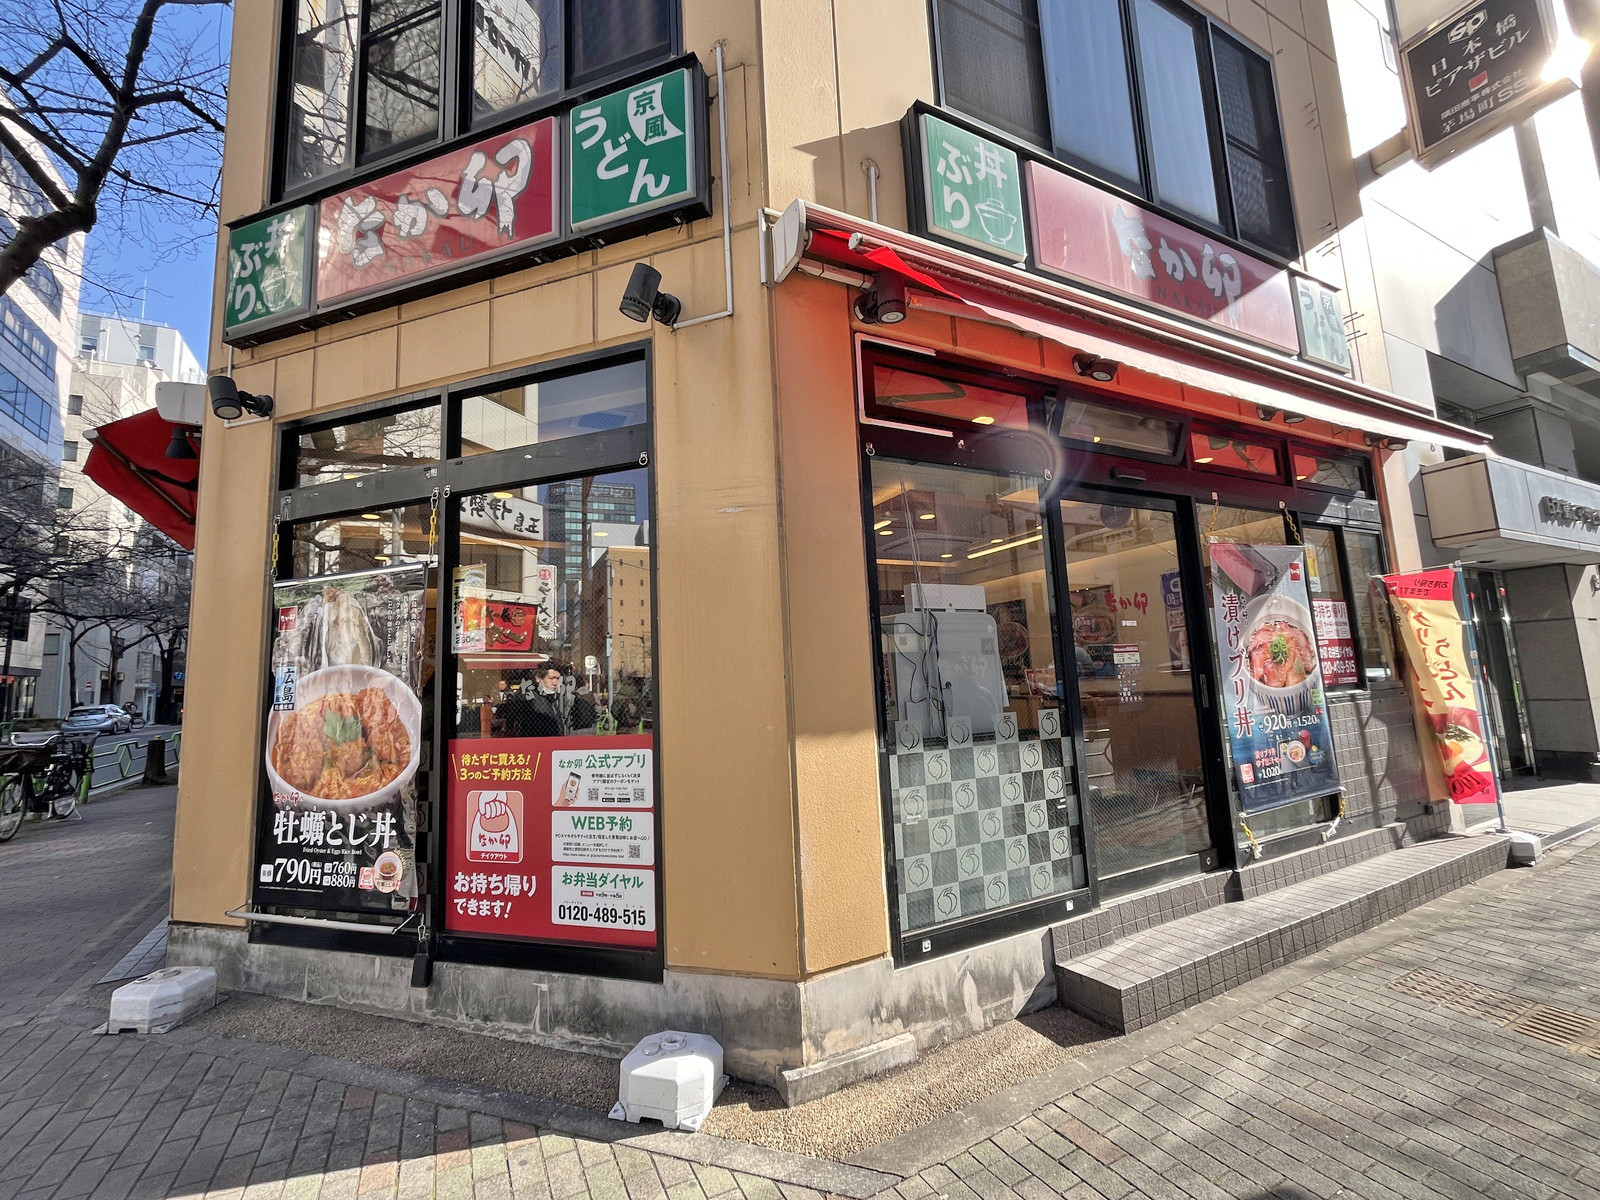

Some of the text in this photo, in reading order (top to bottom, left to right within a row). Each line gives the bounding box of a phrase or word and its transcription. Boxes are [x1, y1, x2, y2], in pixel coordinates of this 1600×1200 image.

[632, 88, 670, 144] 京風
[574, 106, 671, 204] うどん
[975, 141, 1007, 189] 丼
[936, 140, 974, 230] ぶり
[232, 241, 264, 322] ぶり
[1221, 593, 1254, 738] 漬けブリ丼
[282, 668, 295, 702] 広島
[461, 753, 530, 766] 待たずに買える!
[559, 753, 646, 769] なか卯 公式アプリ
[460, 768, 532, 780] 3つのご予約方法
[273, 810, 397, 849] 牡蠣とじ丼
[571, 816, 632, 832] WEB予約
[478, 833, 511, 849] なか卯
[275, 858, 322, 885] 790円
[454, 872, 537, 897] お持ち帰り
[562, 871, 644, 889] お弁当ダイヤル
[454, 899, 512, 919] できます!
[558, 904, 646, 926] 0120-489-515
